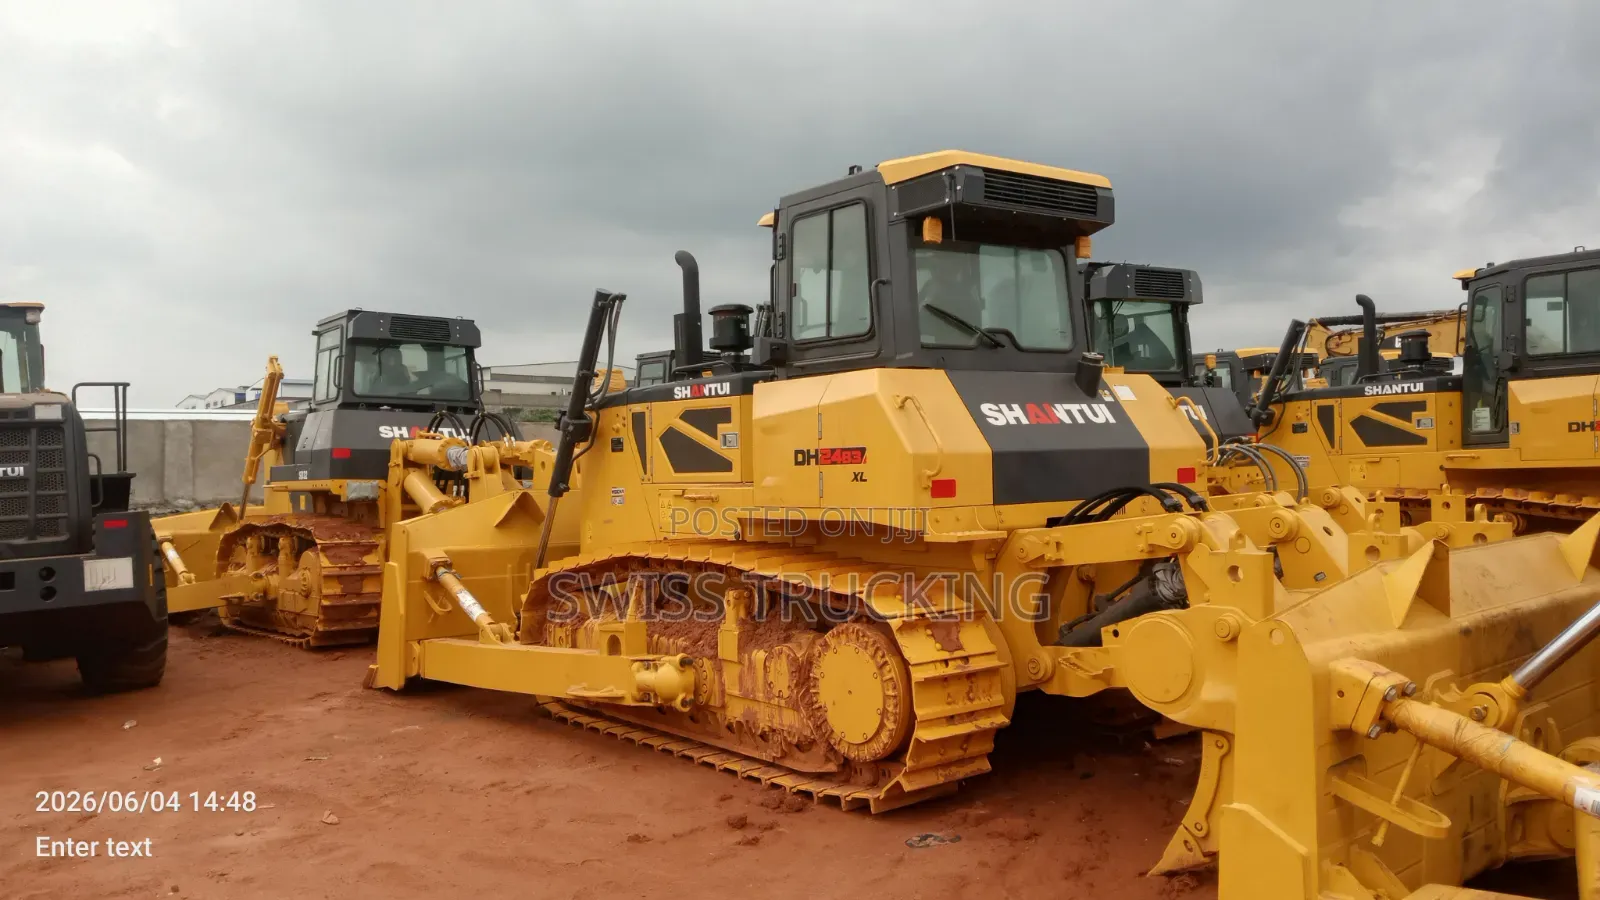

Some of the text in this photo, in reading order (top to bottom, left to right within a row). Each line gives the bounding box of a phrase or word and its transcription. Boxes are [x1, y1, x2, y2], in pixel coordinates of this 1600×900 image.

[673, 382, 730, 399] SHANTUI
[1364, 382, 1424, 396] SHANTUI
[980, 403, 1117, 426] SHANTUI
[851, 471, 867, 482] XL
